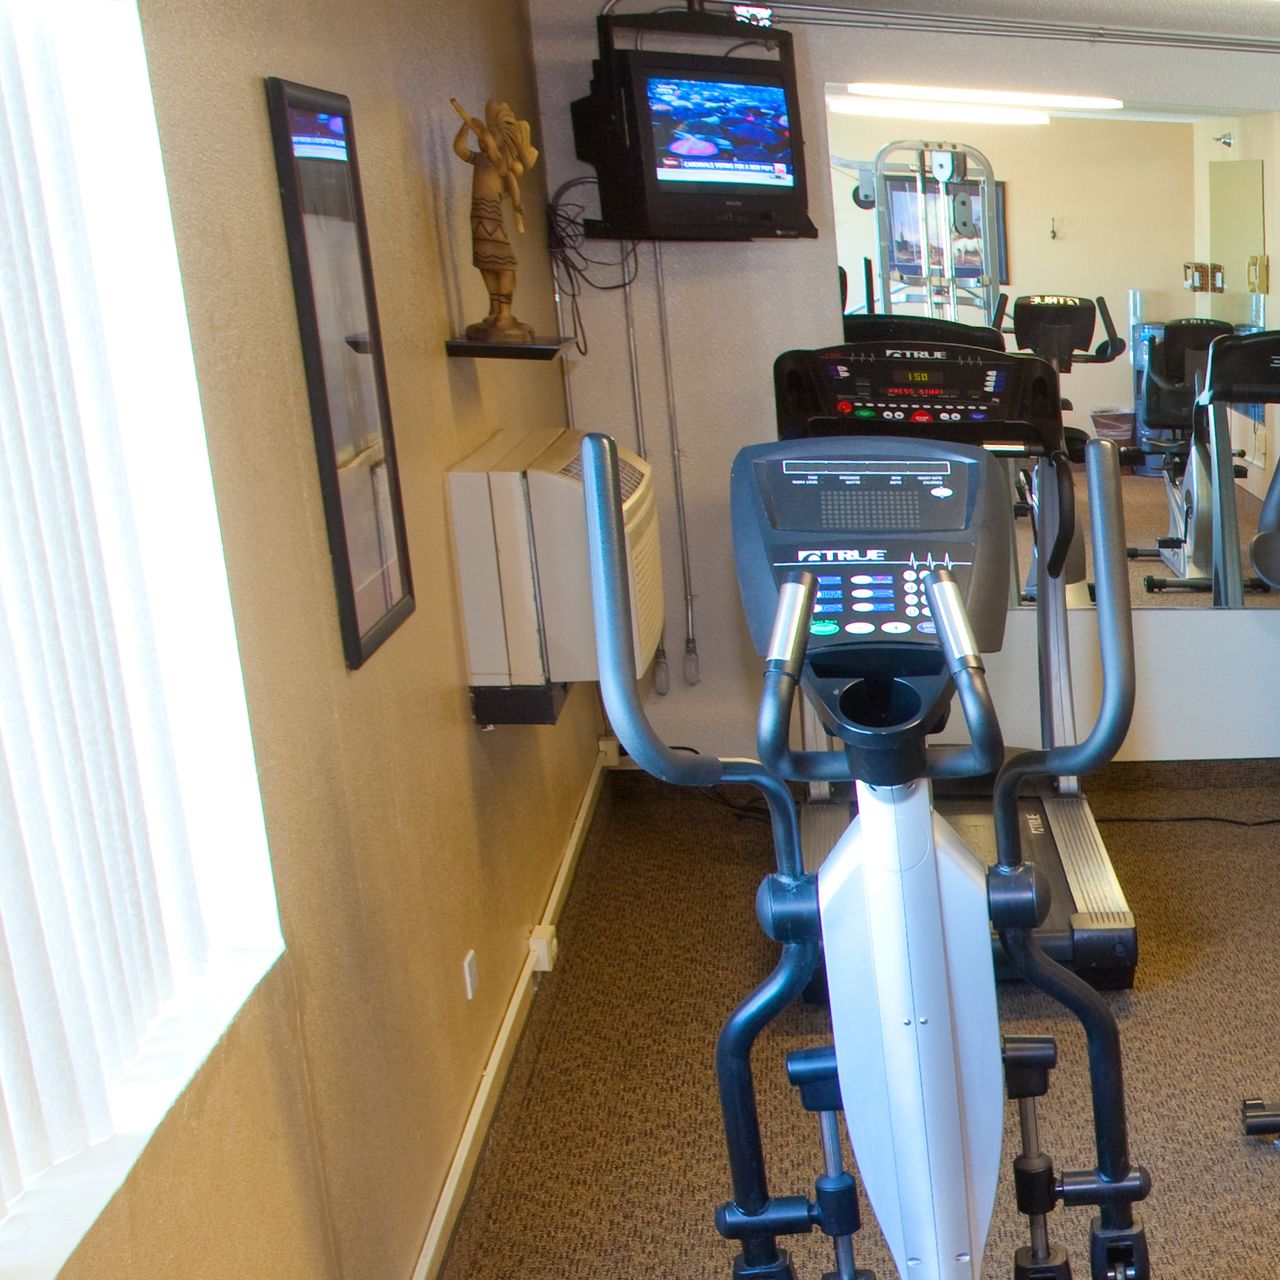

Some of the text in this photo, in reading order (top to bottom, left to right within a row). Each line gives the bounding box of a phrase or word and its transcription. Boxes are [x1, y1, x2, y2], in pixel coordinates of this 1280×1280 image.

[902, 351, 947, 359] TRUE
[908, 373, 929, 382] 150
[821, 550, 887, 561] TRUE
